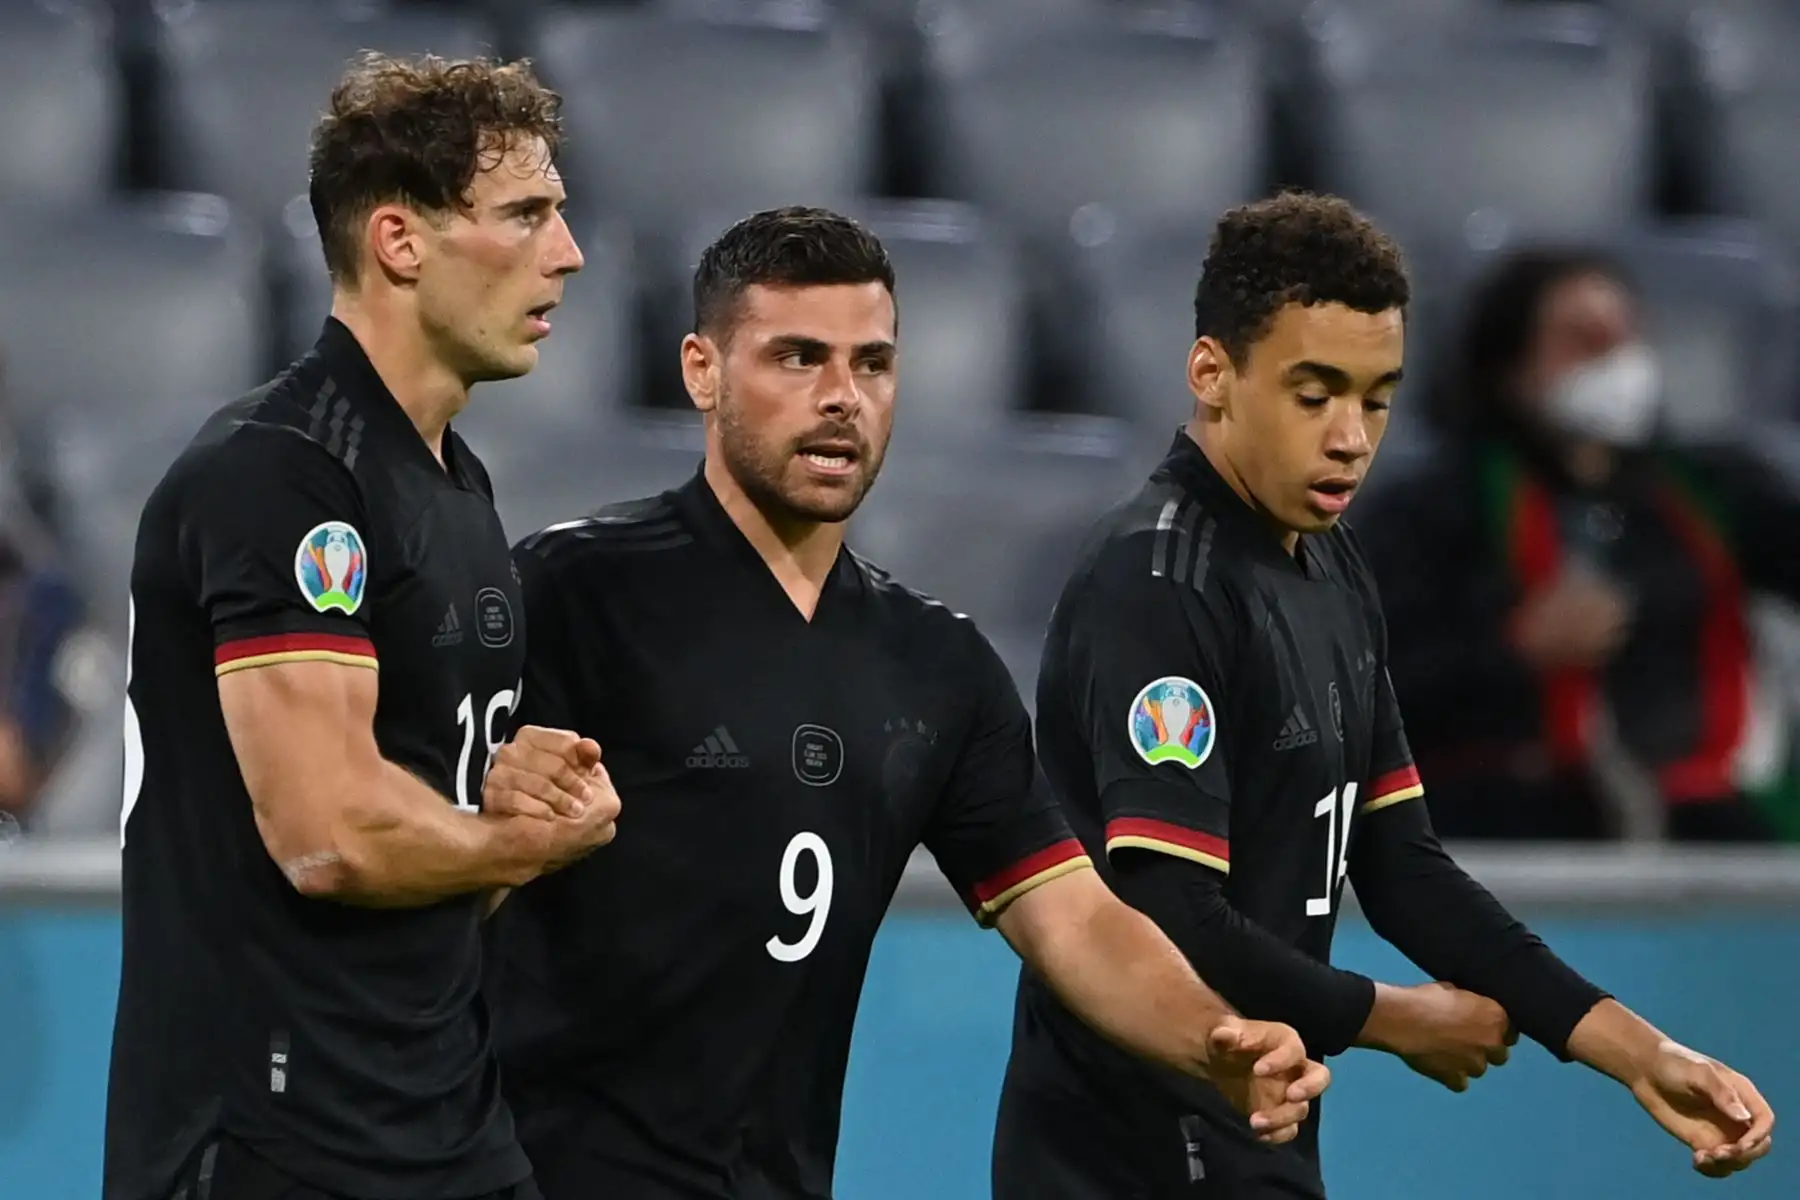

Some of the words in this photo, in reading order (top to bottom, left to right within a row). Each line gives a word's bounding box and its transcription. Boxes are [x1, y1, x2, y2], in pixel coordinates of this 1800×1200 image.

[1272, 730, 1318, 752] adidas
[685, 752, 750, 769] adidas
[765, 831, 834, 963] 9
